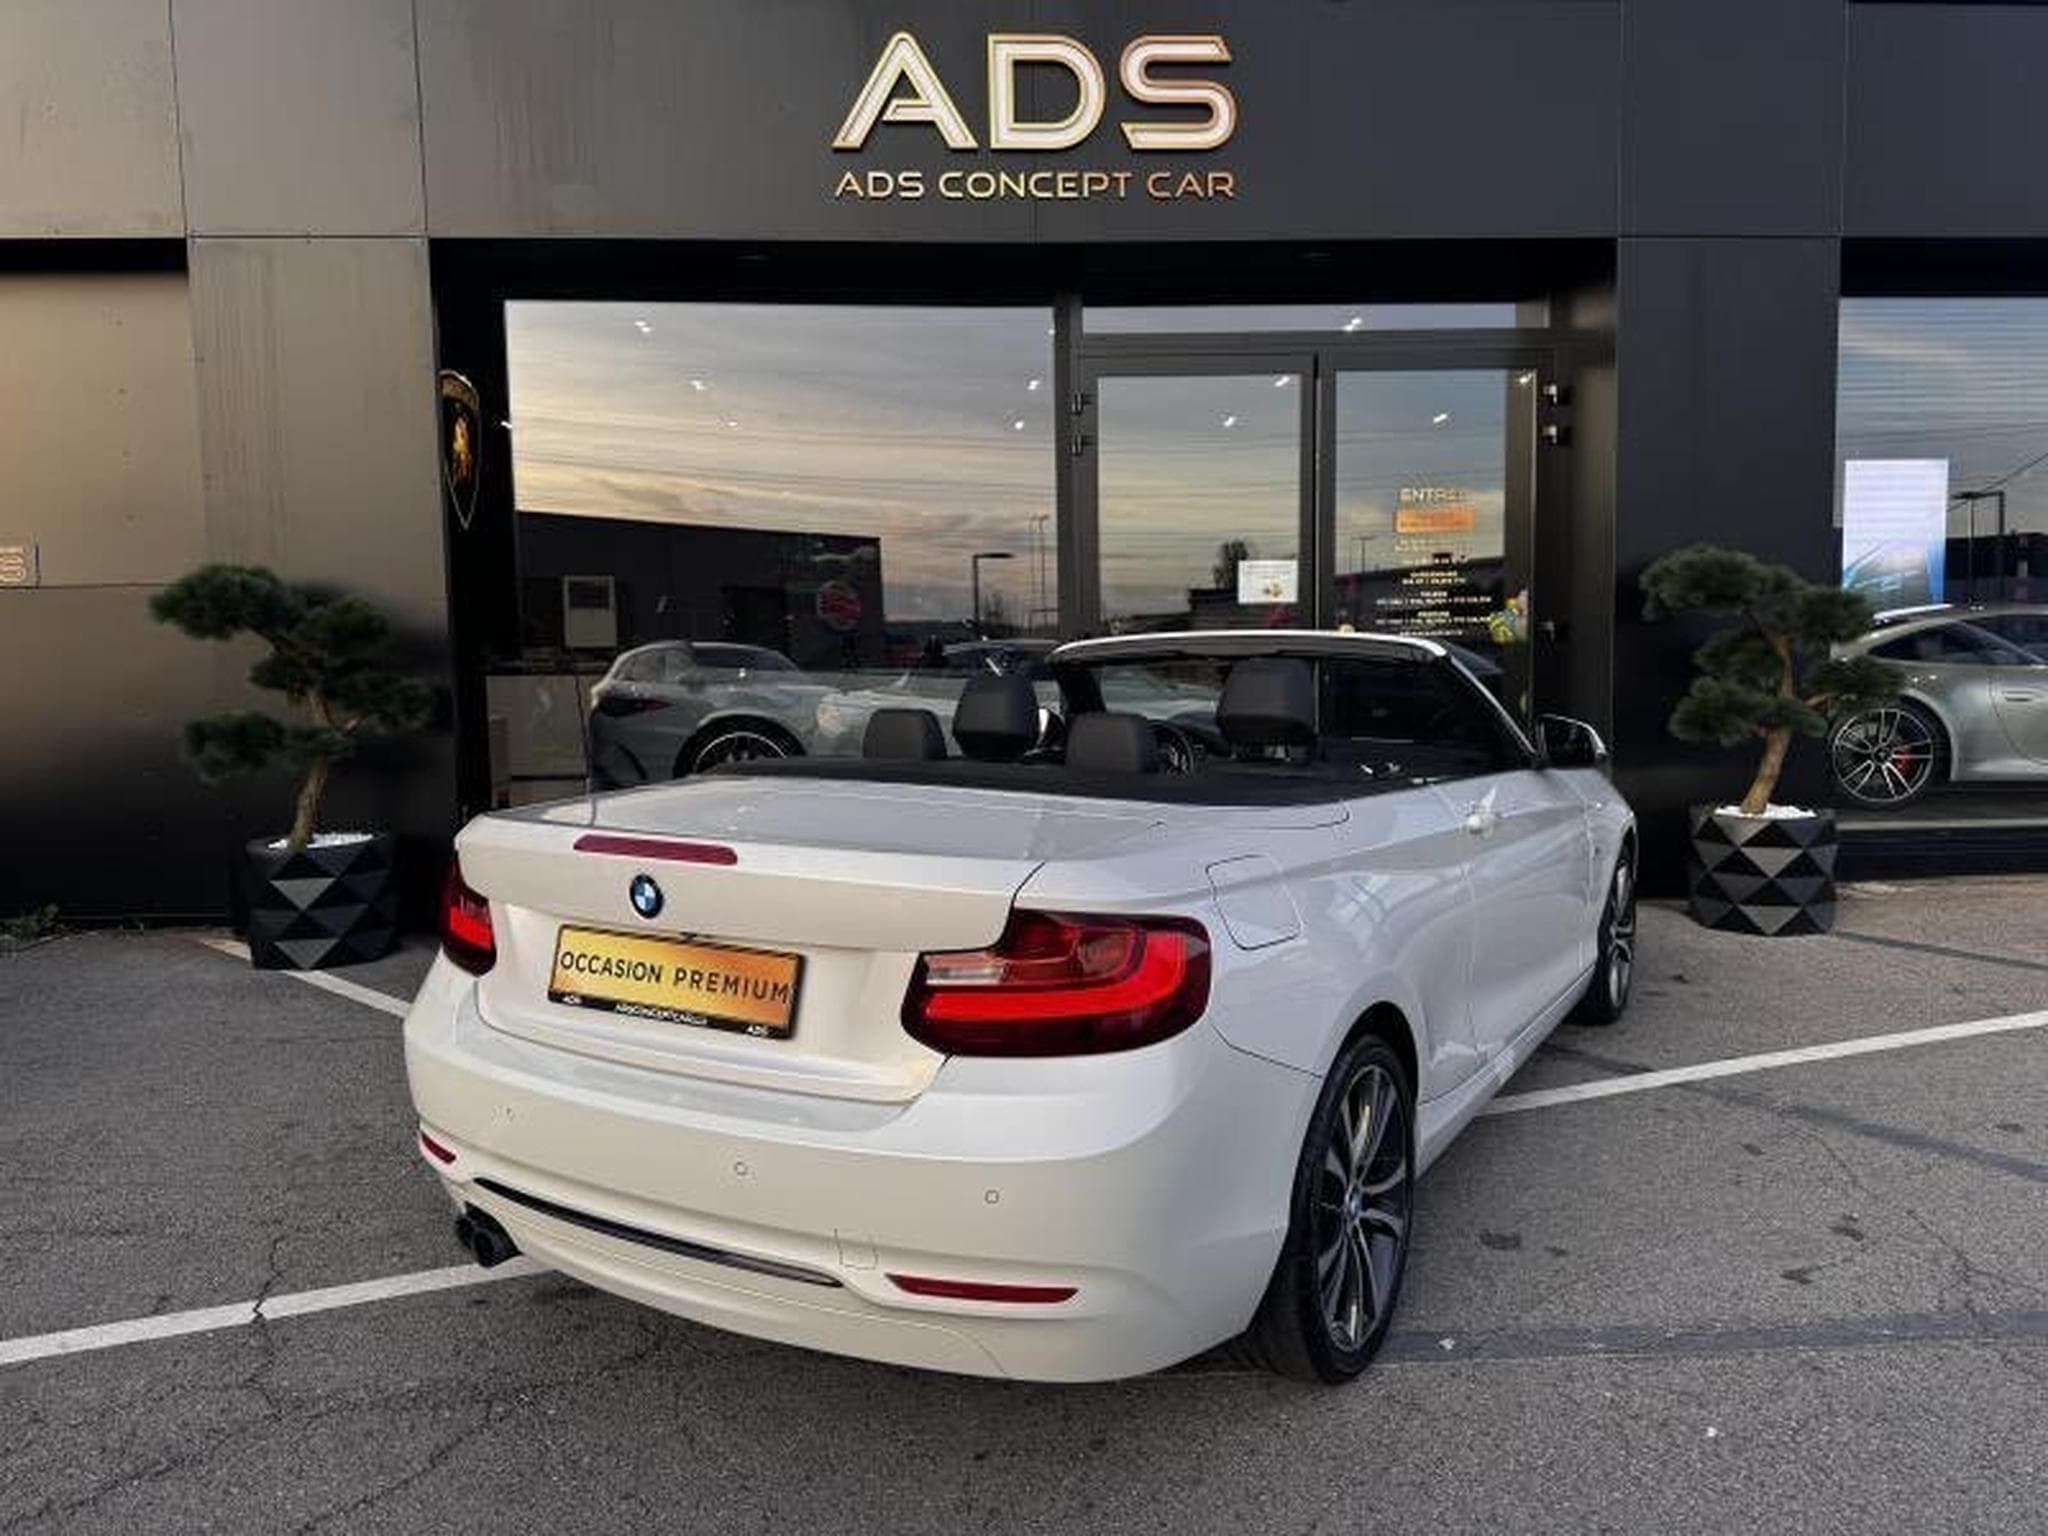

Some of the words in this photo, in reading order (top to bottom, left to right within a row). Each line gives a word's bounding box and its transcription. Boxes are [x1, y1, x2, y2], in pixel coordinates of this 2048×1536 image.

[832, 31, 1238, 150] ADS
[834, 171, 924, 198] ADS
[938, 171, 1132, 198] CONCEPT
[1145, 171, 1235, 198] CAR
[560, 951, 663, 984] OCCASION
[673, 966, 790, 1004] PREMIUM
